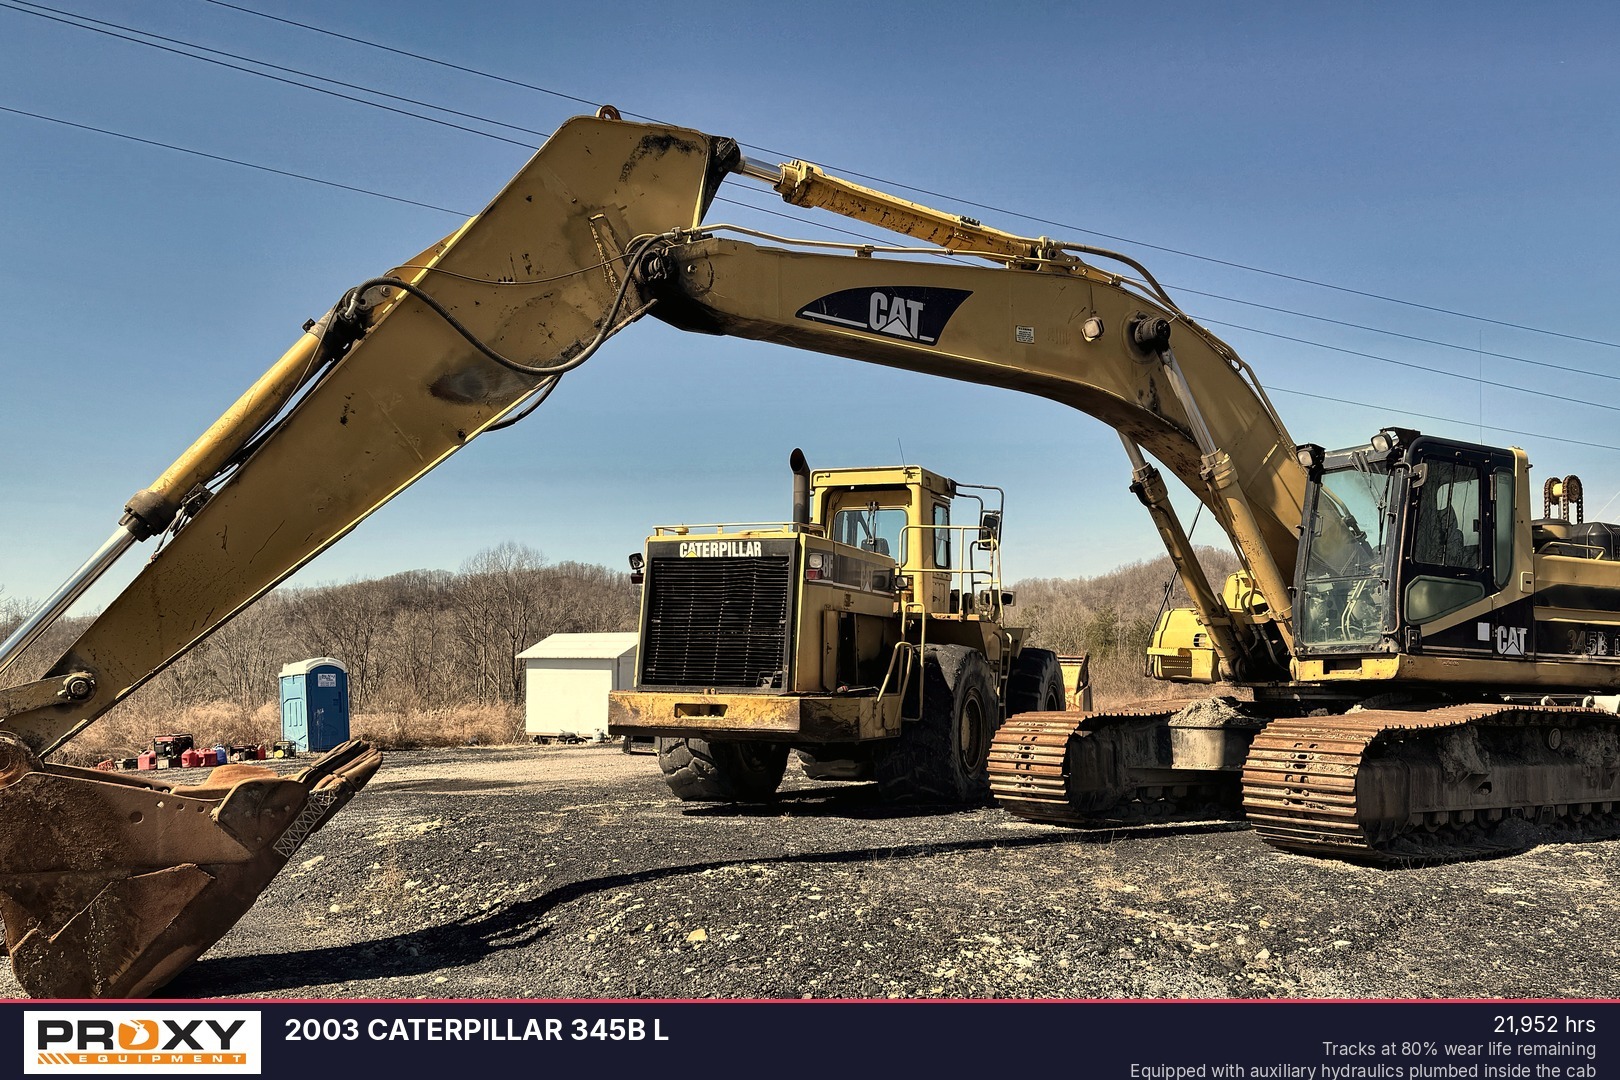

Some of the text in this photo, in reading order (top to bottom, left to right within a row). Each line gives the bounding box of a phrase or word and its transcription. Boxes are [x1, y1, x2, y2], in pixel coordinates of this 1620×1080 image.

[868, 291, 924, 339] CAT
[679, 541, 762, 558] CATERPILLAR
[1496, 625, 1528, 656] CAT
[1567, 629, 1608, 656] 345B
